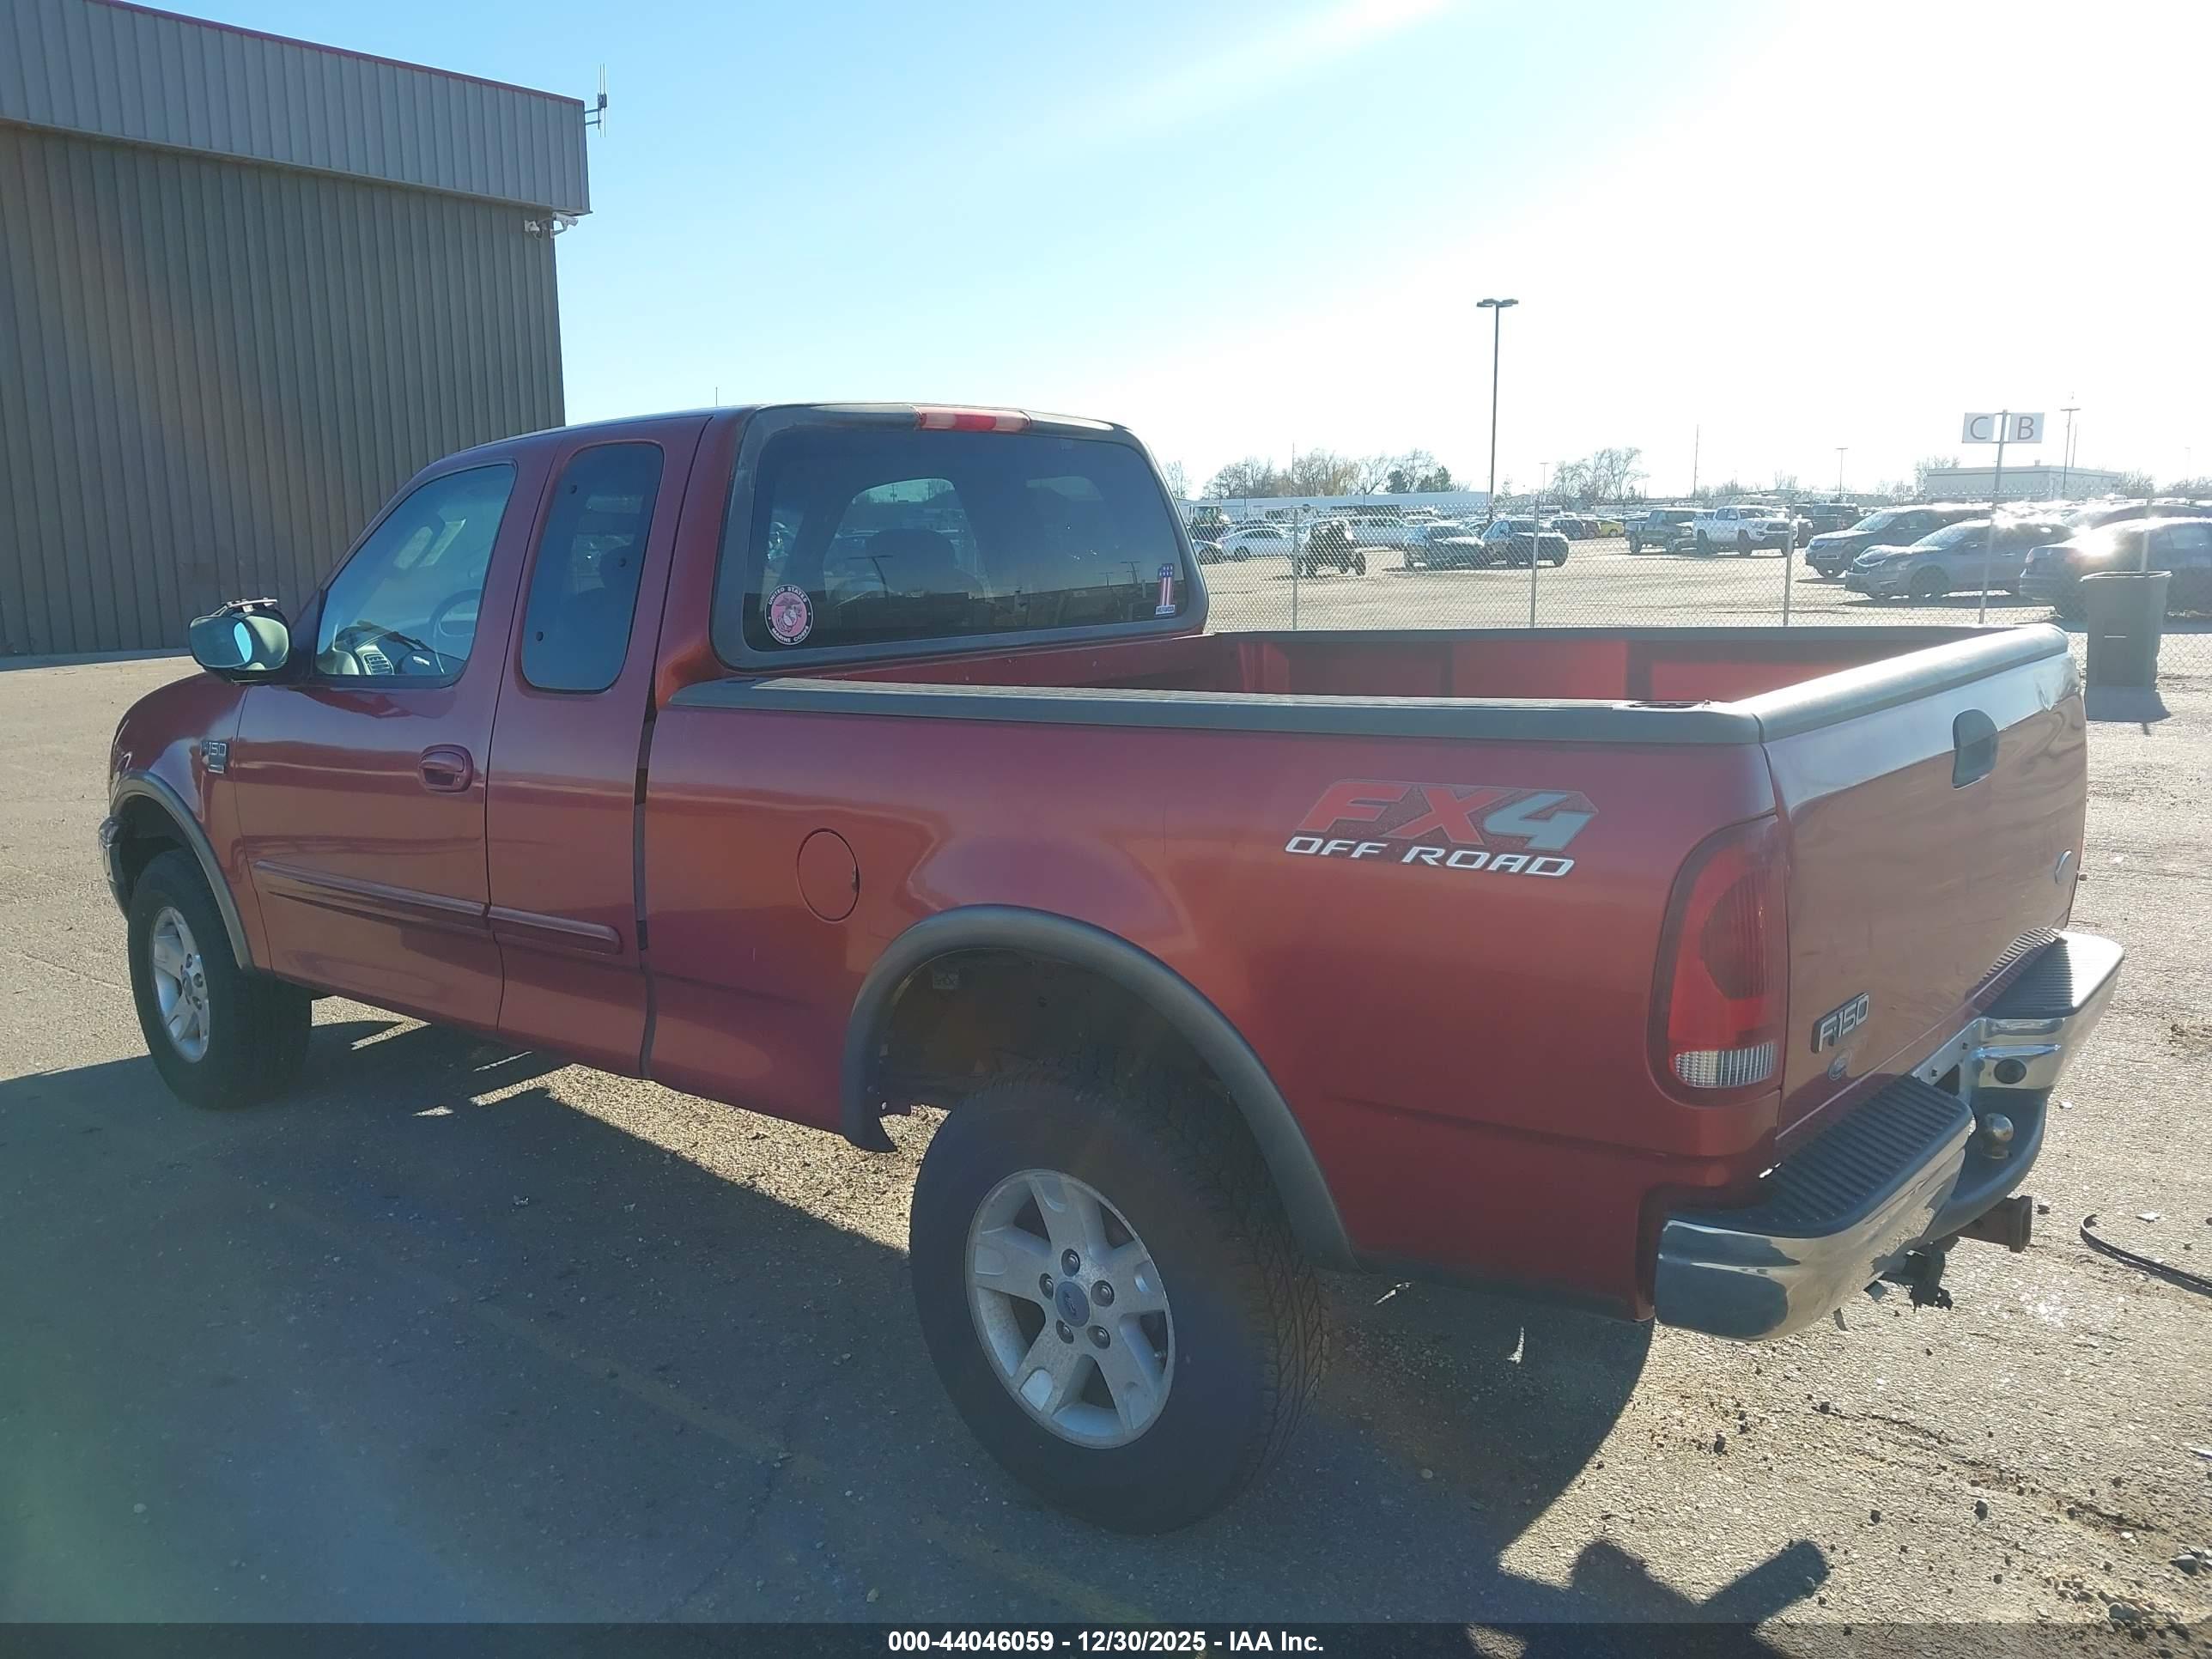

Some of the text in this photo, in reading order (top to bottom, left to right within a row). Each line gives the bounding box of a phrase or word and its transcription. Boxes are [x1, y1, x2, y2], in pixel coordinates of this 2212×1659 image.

[1970, 416, 1989, 441] C
[2017, 416, 2034, 441] B
[768, 586, 808, 605] UNITED STATES
[771, 627, 792, 643] MARINE
[1292, 779, 1595, 851] FX4
[1285, 836, 1576, 877] OFF ROAD
[1817, 993, 1869, 1052] F150
